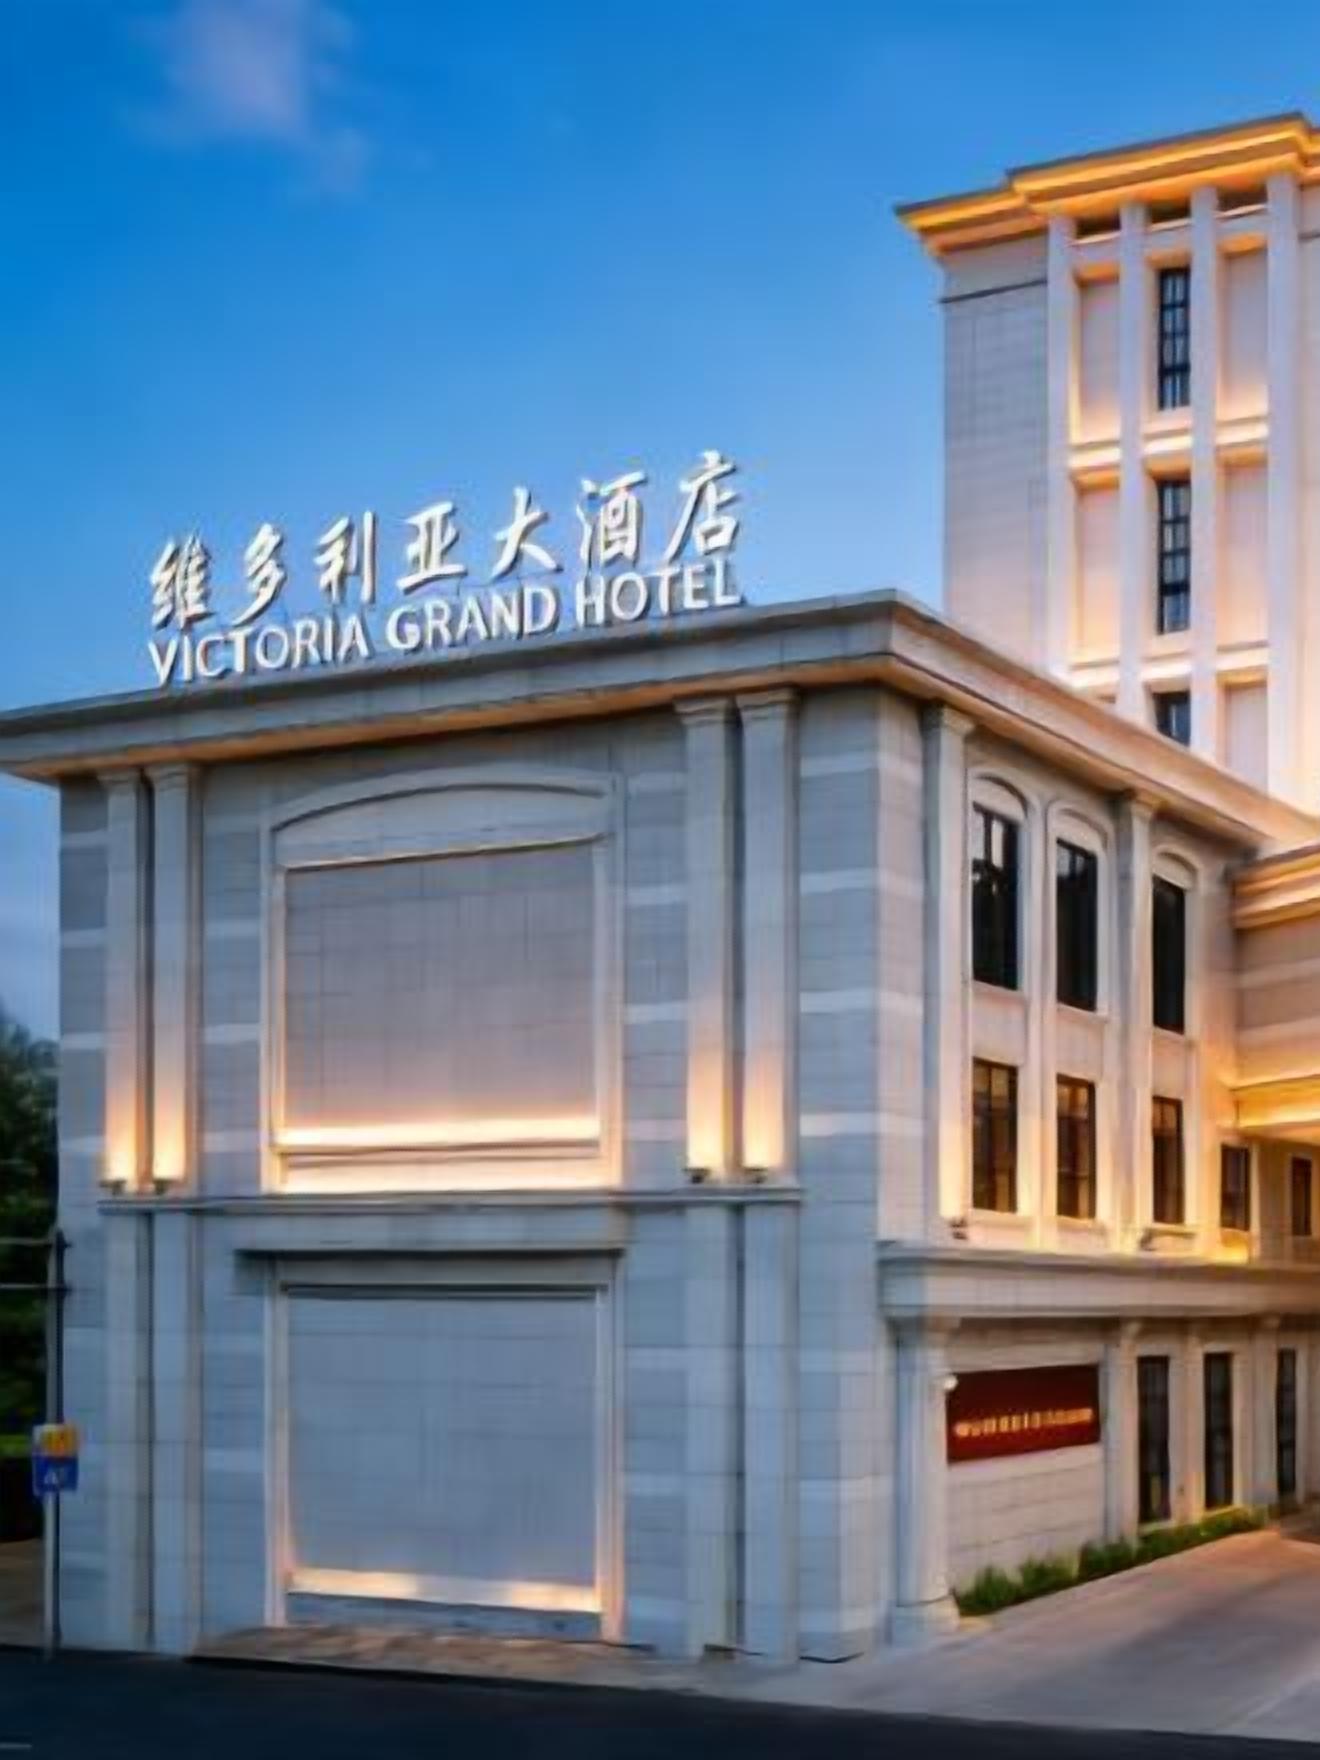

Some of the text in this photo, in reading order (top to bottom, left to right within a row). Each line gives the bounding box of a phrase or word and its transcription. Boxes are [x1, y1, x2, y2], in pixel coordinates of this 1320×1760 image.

[149, 448, 742, 633] 维多利亚大酒店
[148, 557, 742, 686] VICTORIA GRAND HOTEL
